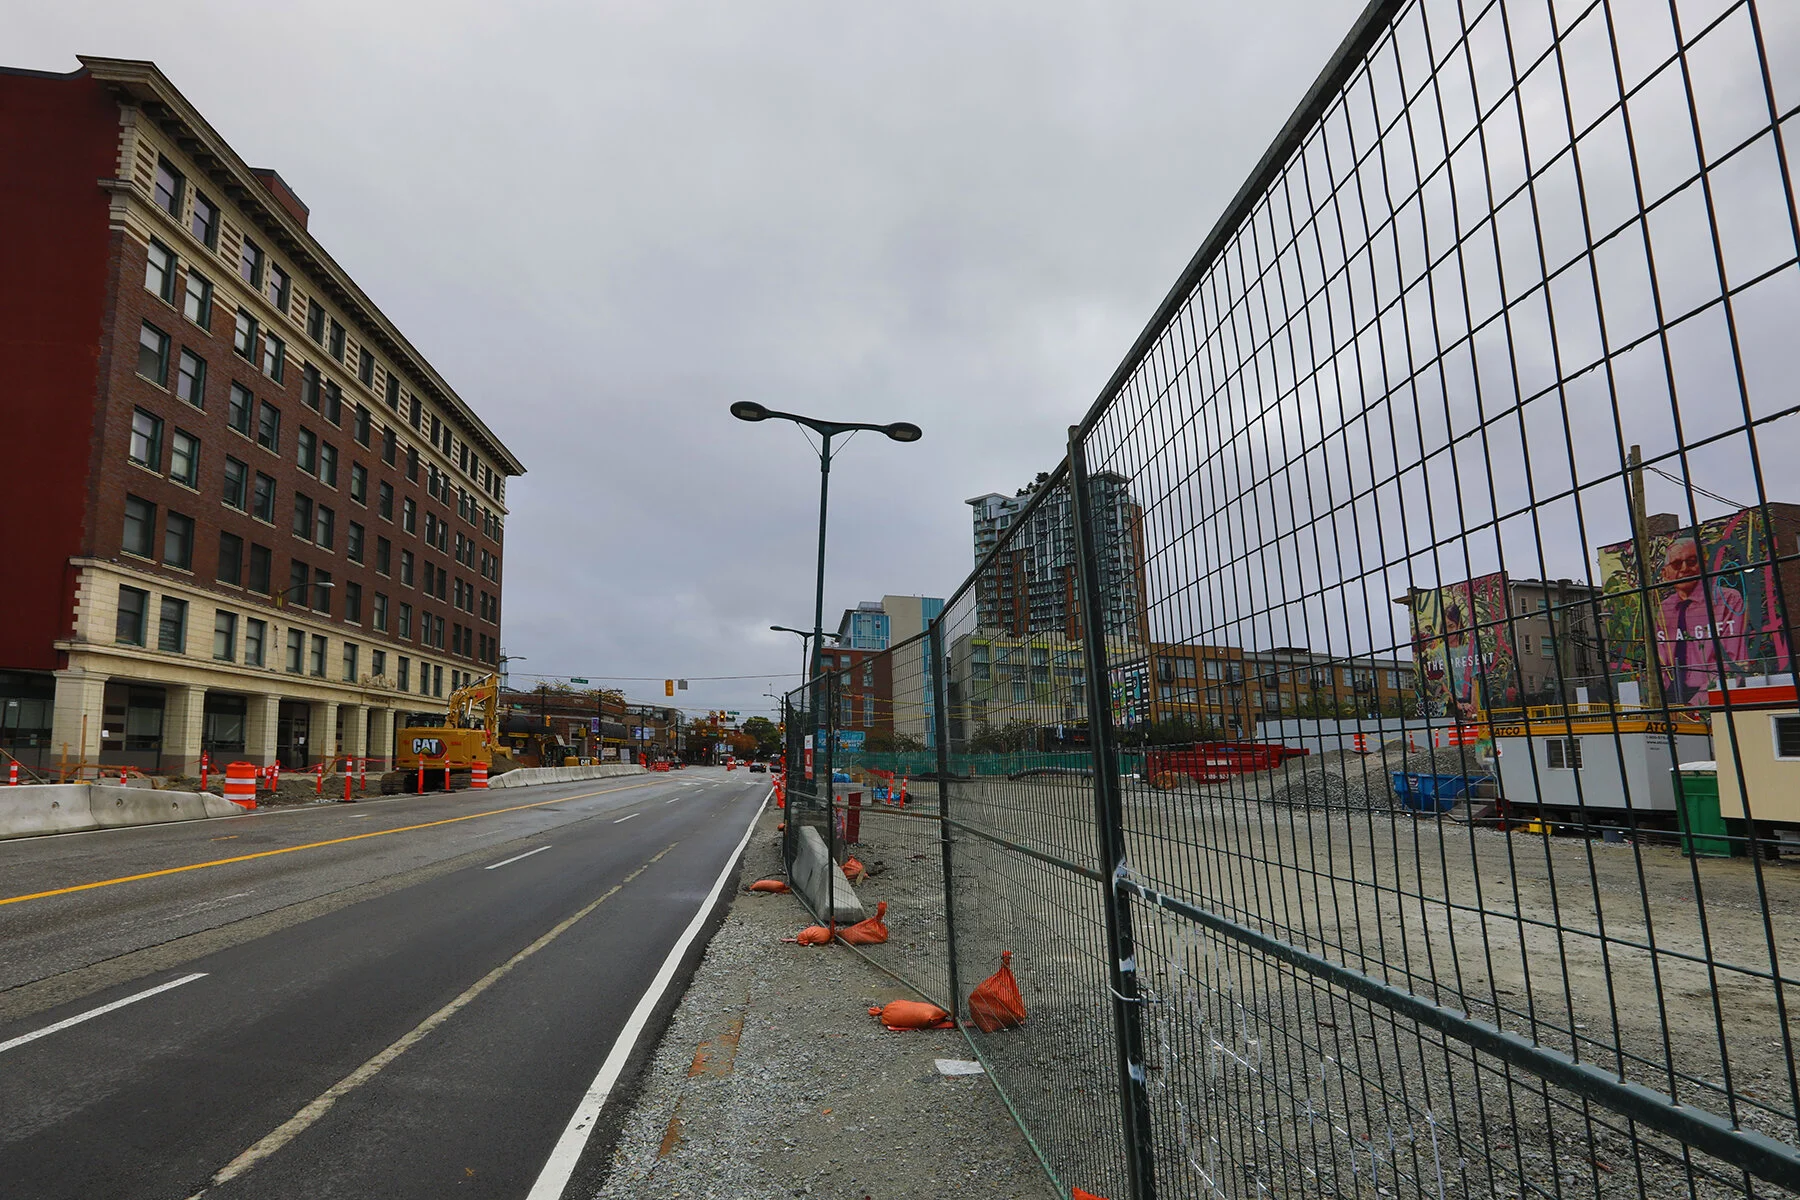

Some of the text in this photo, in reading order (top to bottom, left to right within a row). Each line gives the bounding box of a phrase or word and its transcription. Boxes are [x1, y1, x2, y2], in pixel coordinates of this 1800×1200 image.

[1676, 628, 1684, 640] A
[1694, 619, 1735, 640] GIFT
[1427, 659, 1445, 671] THE
[1495, 726, 1520, 736] ATCO
[412, 738, 439, 754] CAT
